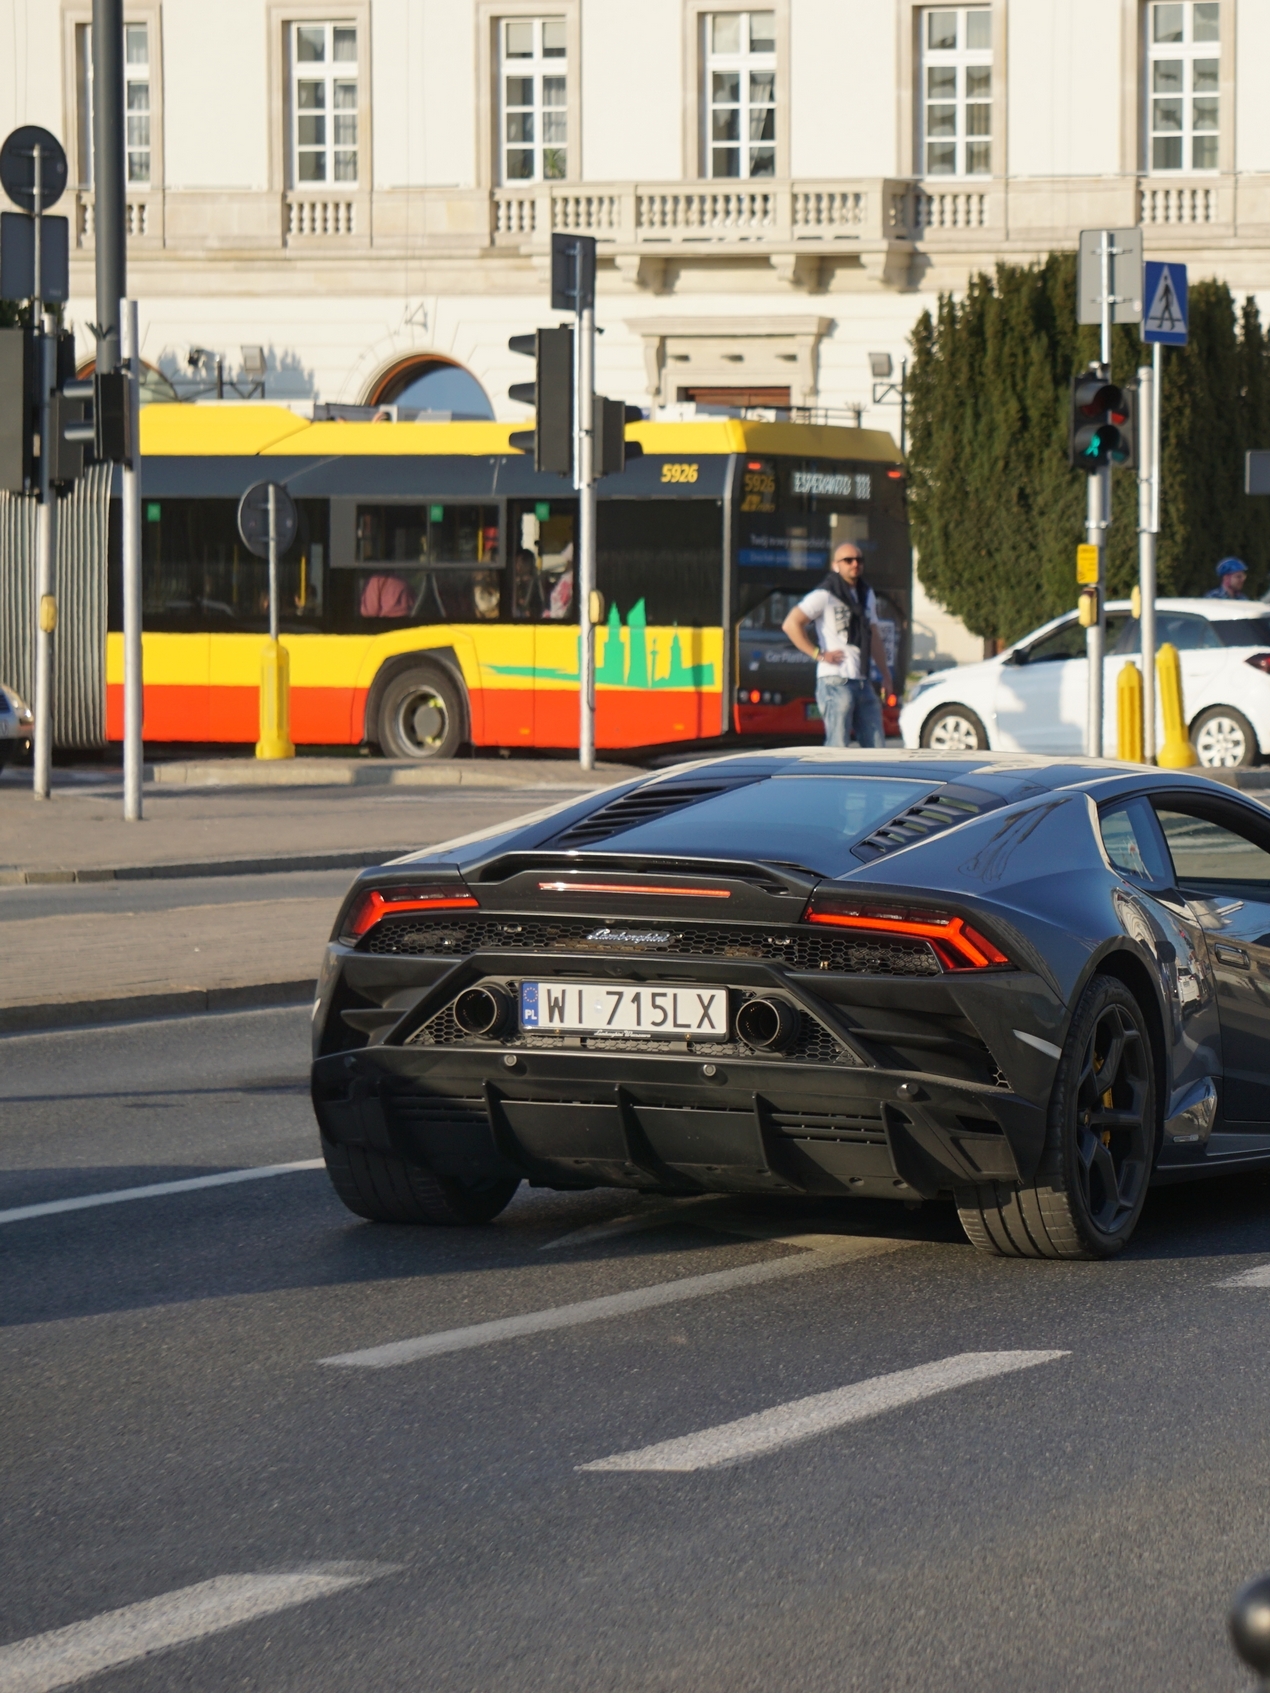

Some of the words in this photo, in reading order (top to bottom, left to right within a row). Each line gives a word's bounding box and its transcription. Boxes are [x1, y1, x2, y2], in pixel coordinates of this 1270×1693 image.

[661, 463, 698, 483] 5926
[744, 474, 775, 493] 5926
[587, 928, 670, 944] Lamborghini
[525, 1009, 538, 1020] PL
[547, 988, 584, 1025] WI
[605, 991, 717, 1030] 715LX
